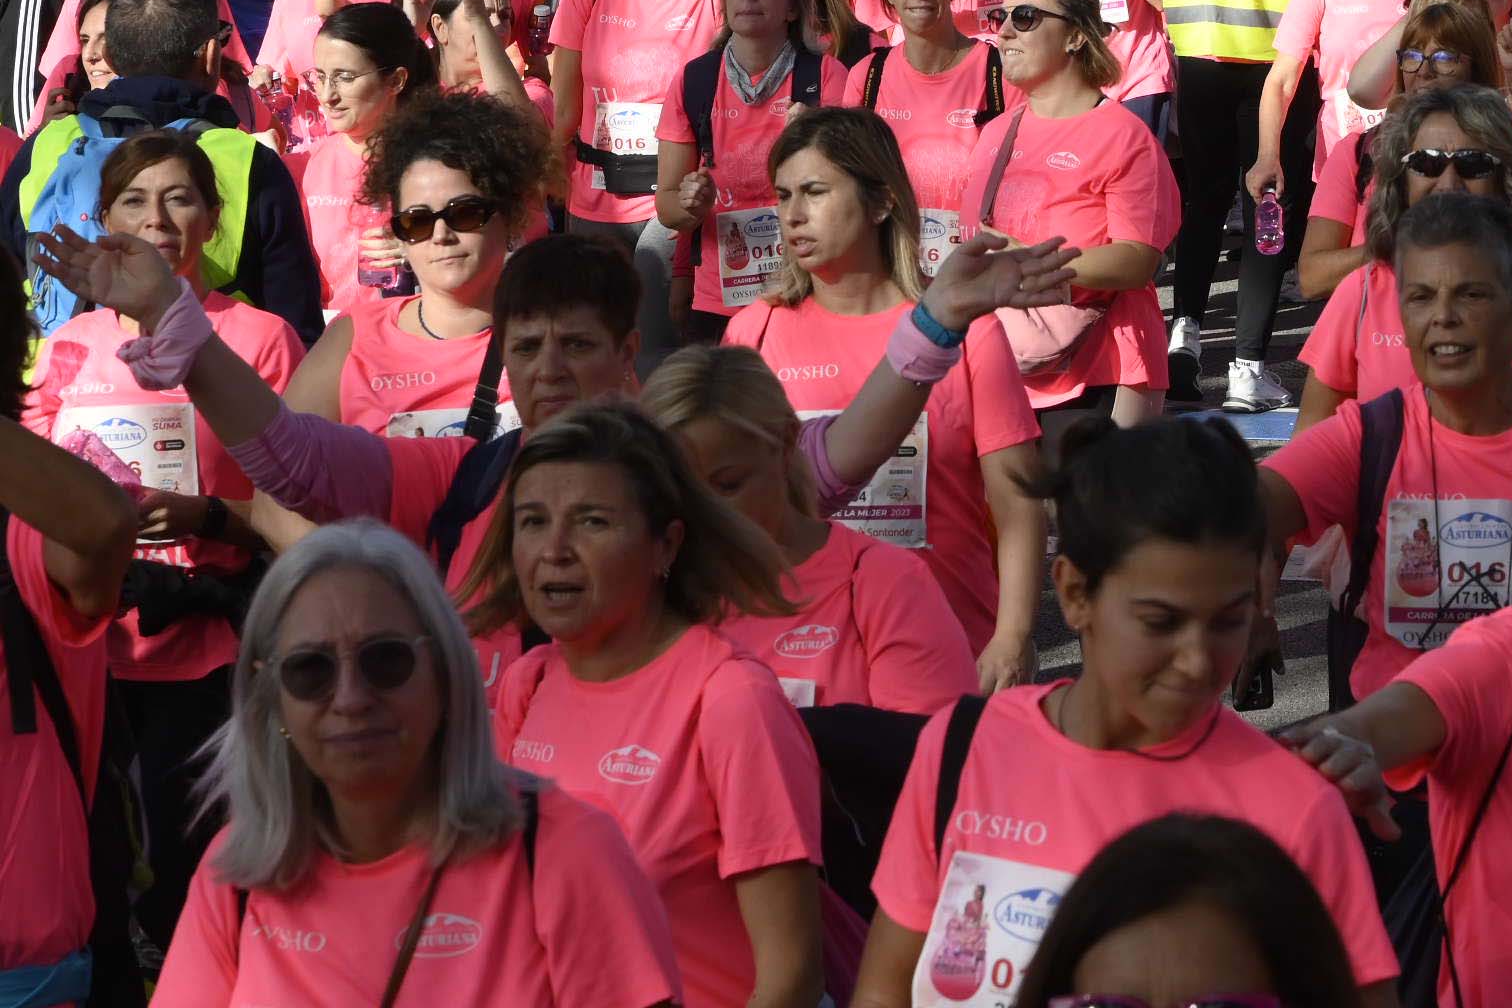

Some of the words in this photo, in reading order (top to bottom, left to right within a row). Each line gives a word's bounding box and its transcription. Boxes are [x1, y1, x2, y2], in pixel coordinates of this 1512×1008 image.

[614, 137, 646, 150] 016
[751, 242, 784, 260] 016
[1371, 331, 1403, 347] OYS
[777, 363, 840, 382] OYSHO
[370, 371, 436, 392] OYSHO
[152, 422, 183, 431] SUMA
[845, 509, 856, 517] LA
[857, 509, 888, 517] MUJER
[1446, 526, 1509, 541] ASTURIANA
[1447, 561, 1506, 584] 016
